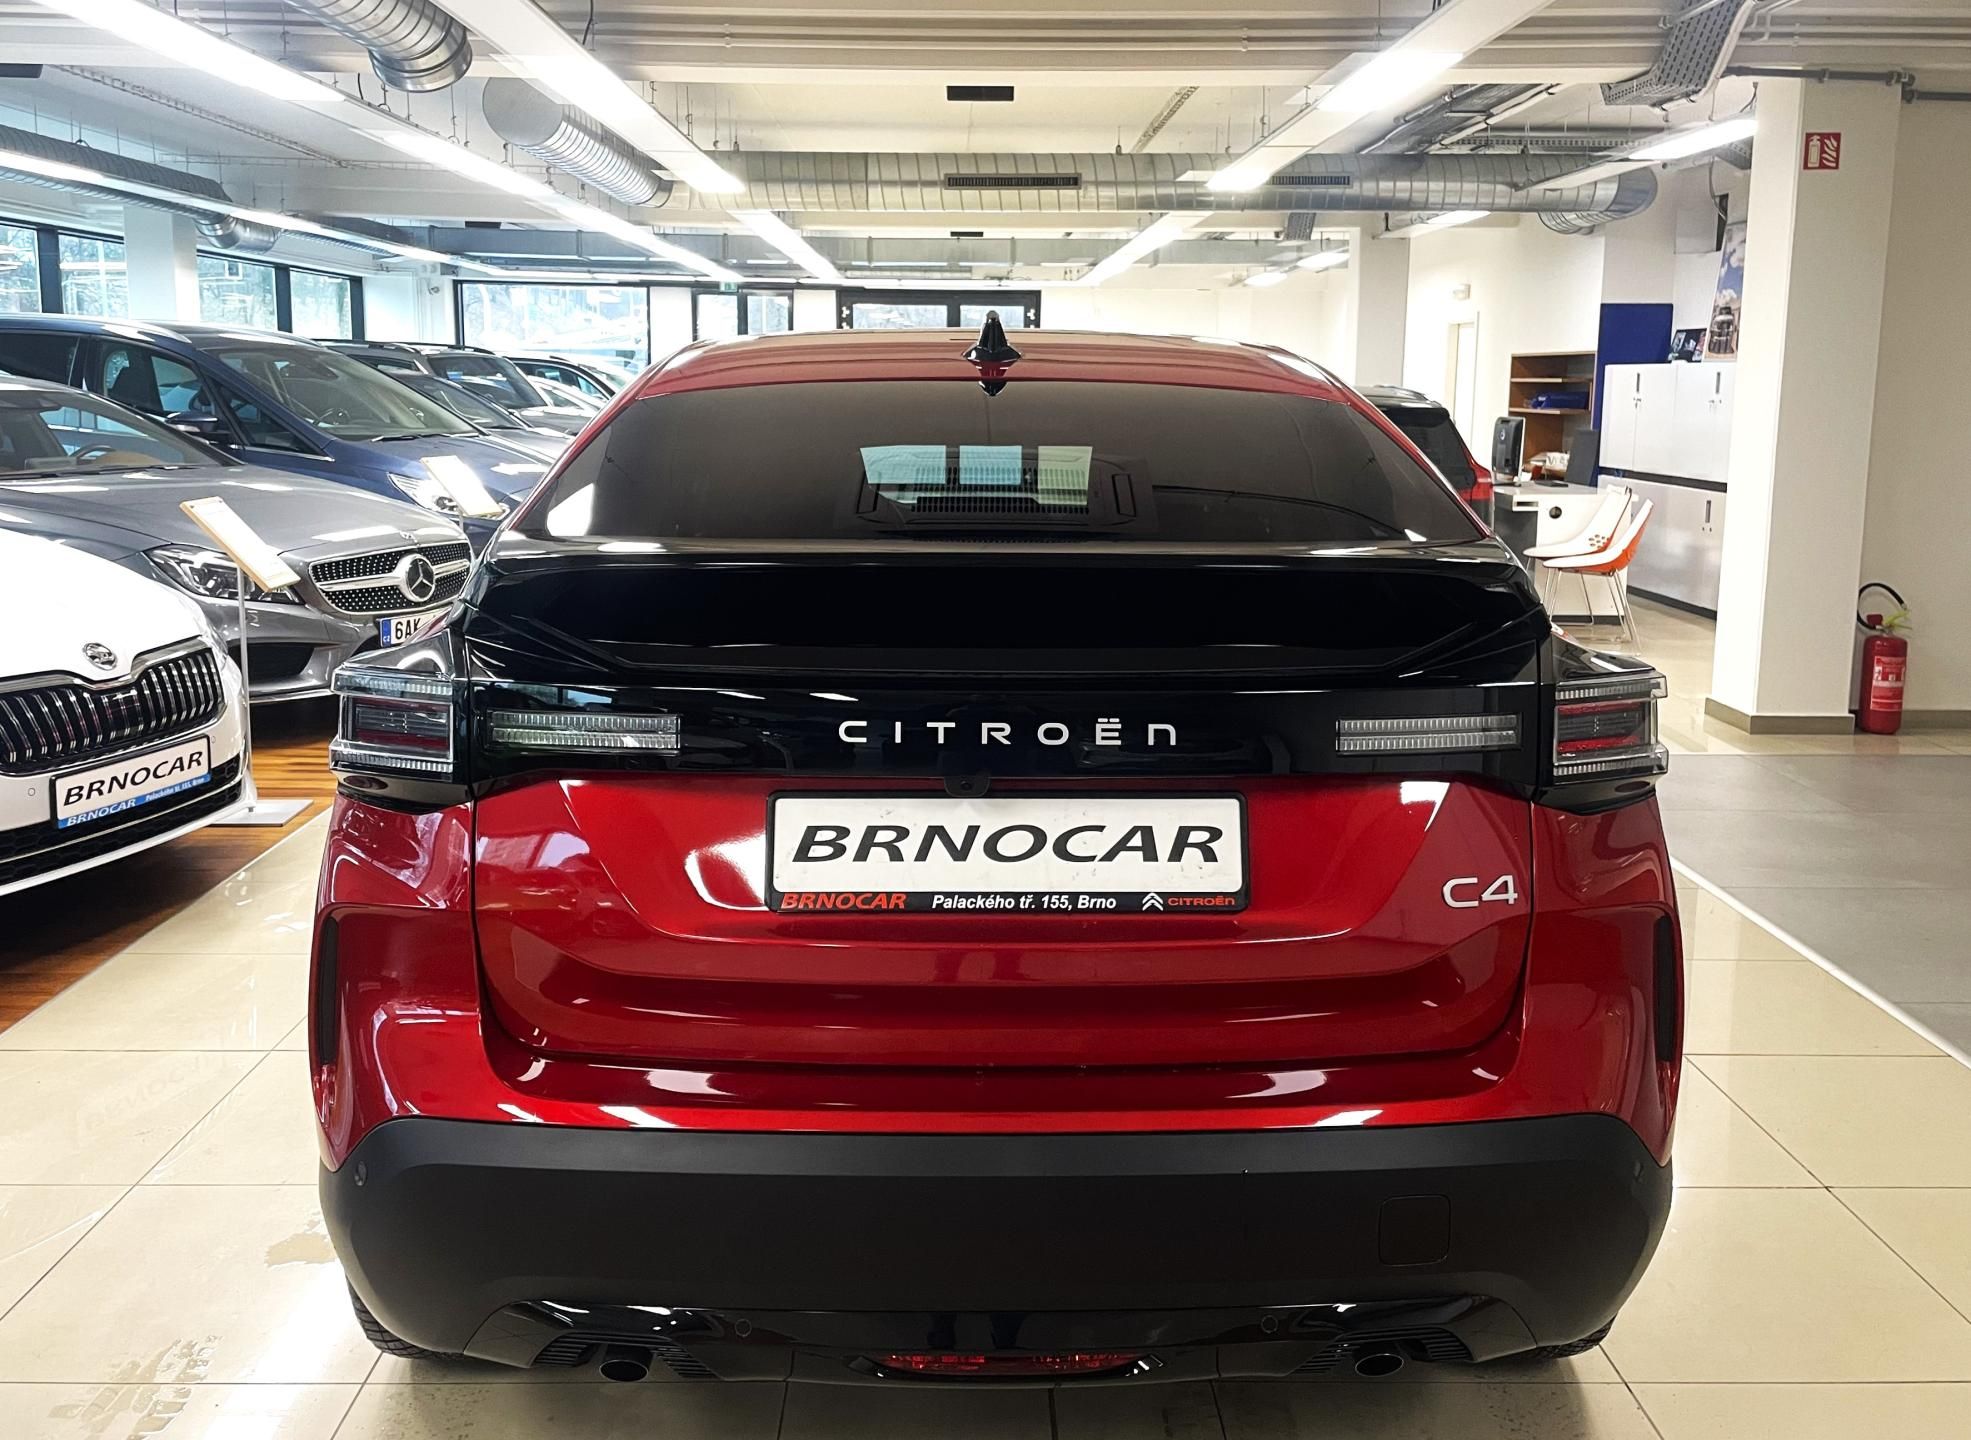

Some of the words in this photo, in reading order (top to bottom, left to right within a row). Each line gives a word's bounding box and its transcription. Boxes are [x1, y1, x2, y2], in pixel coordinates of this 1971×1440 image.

[63, 750, 204, 807] BRNOCAR
[66, 798, 137, 827] BRNOCAR
[791, 823, 1224, 864] BRNOCAR
[780, 892, 907, 910] BRNOCAR
[931, 894, 1015, 910] Palackého
[1019, 893, 1036, 909] tř.
[1041, 895, 1073, 911] 155,
[1077, 894, 1117, 910] Brno
[1442, 874, 1519, 908] C4
